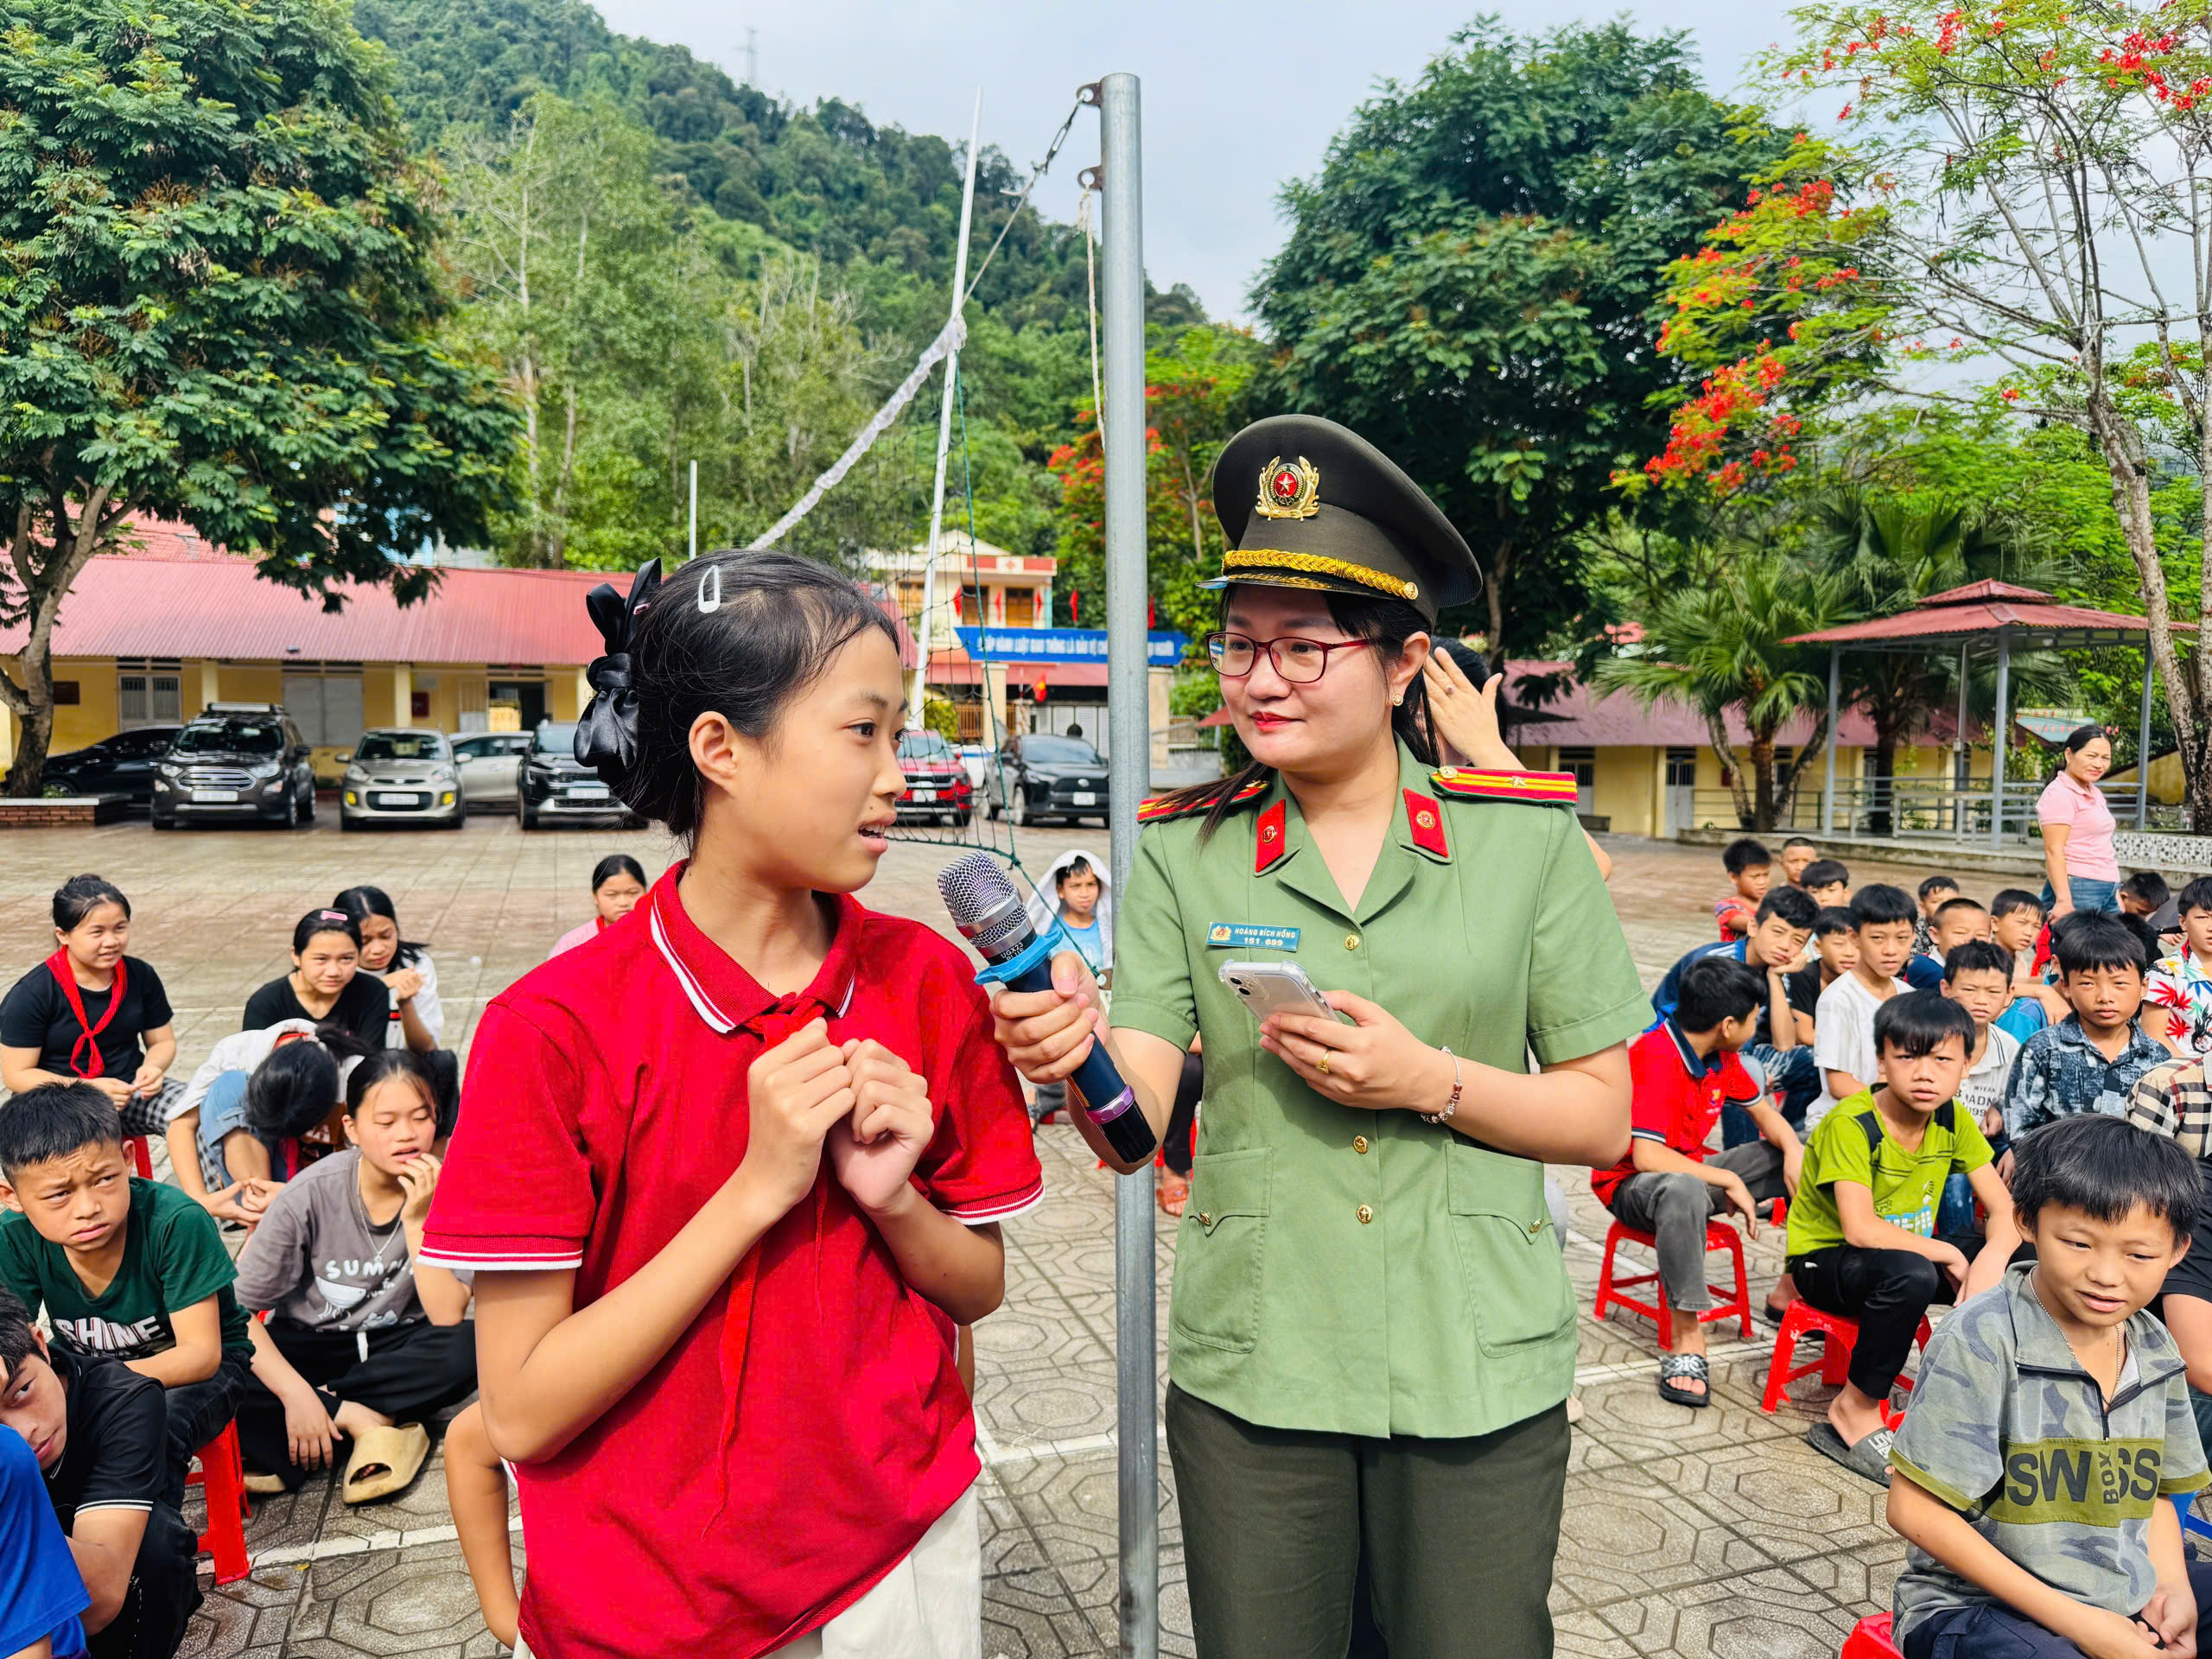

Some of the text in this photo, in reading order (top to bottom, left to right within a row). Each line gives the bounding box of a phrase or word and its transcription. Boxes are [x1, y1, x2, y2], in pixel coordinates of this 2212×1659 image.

[1001, 942, 1024, 958] UGX23
[54, 1315, 166, 1351] SHINE
[2098, 1451, 2120, 1504] BOX
